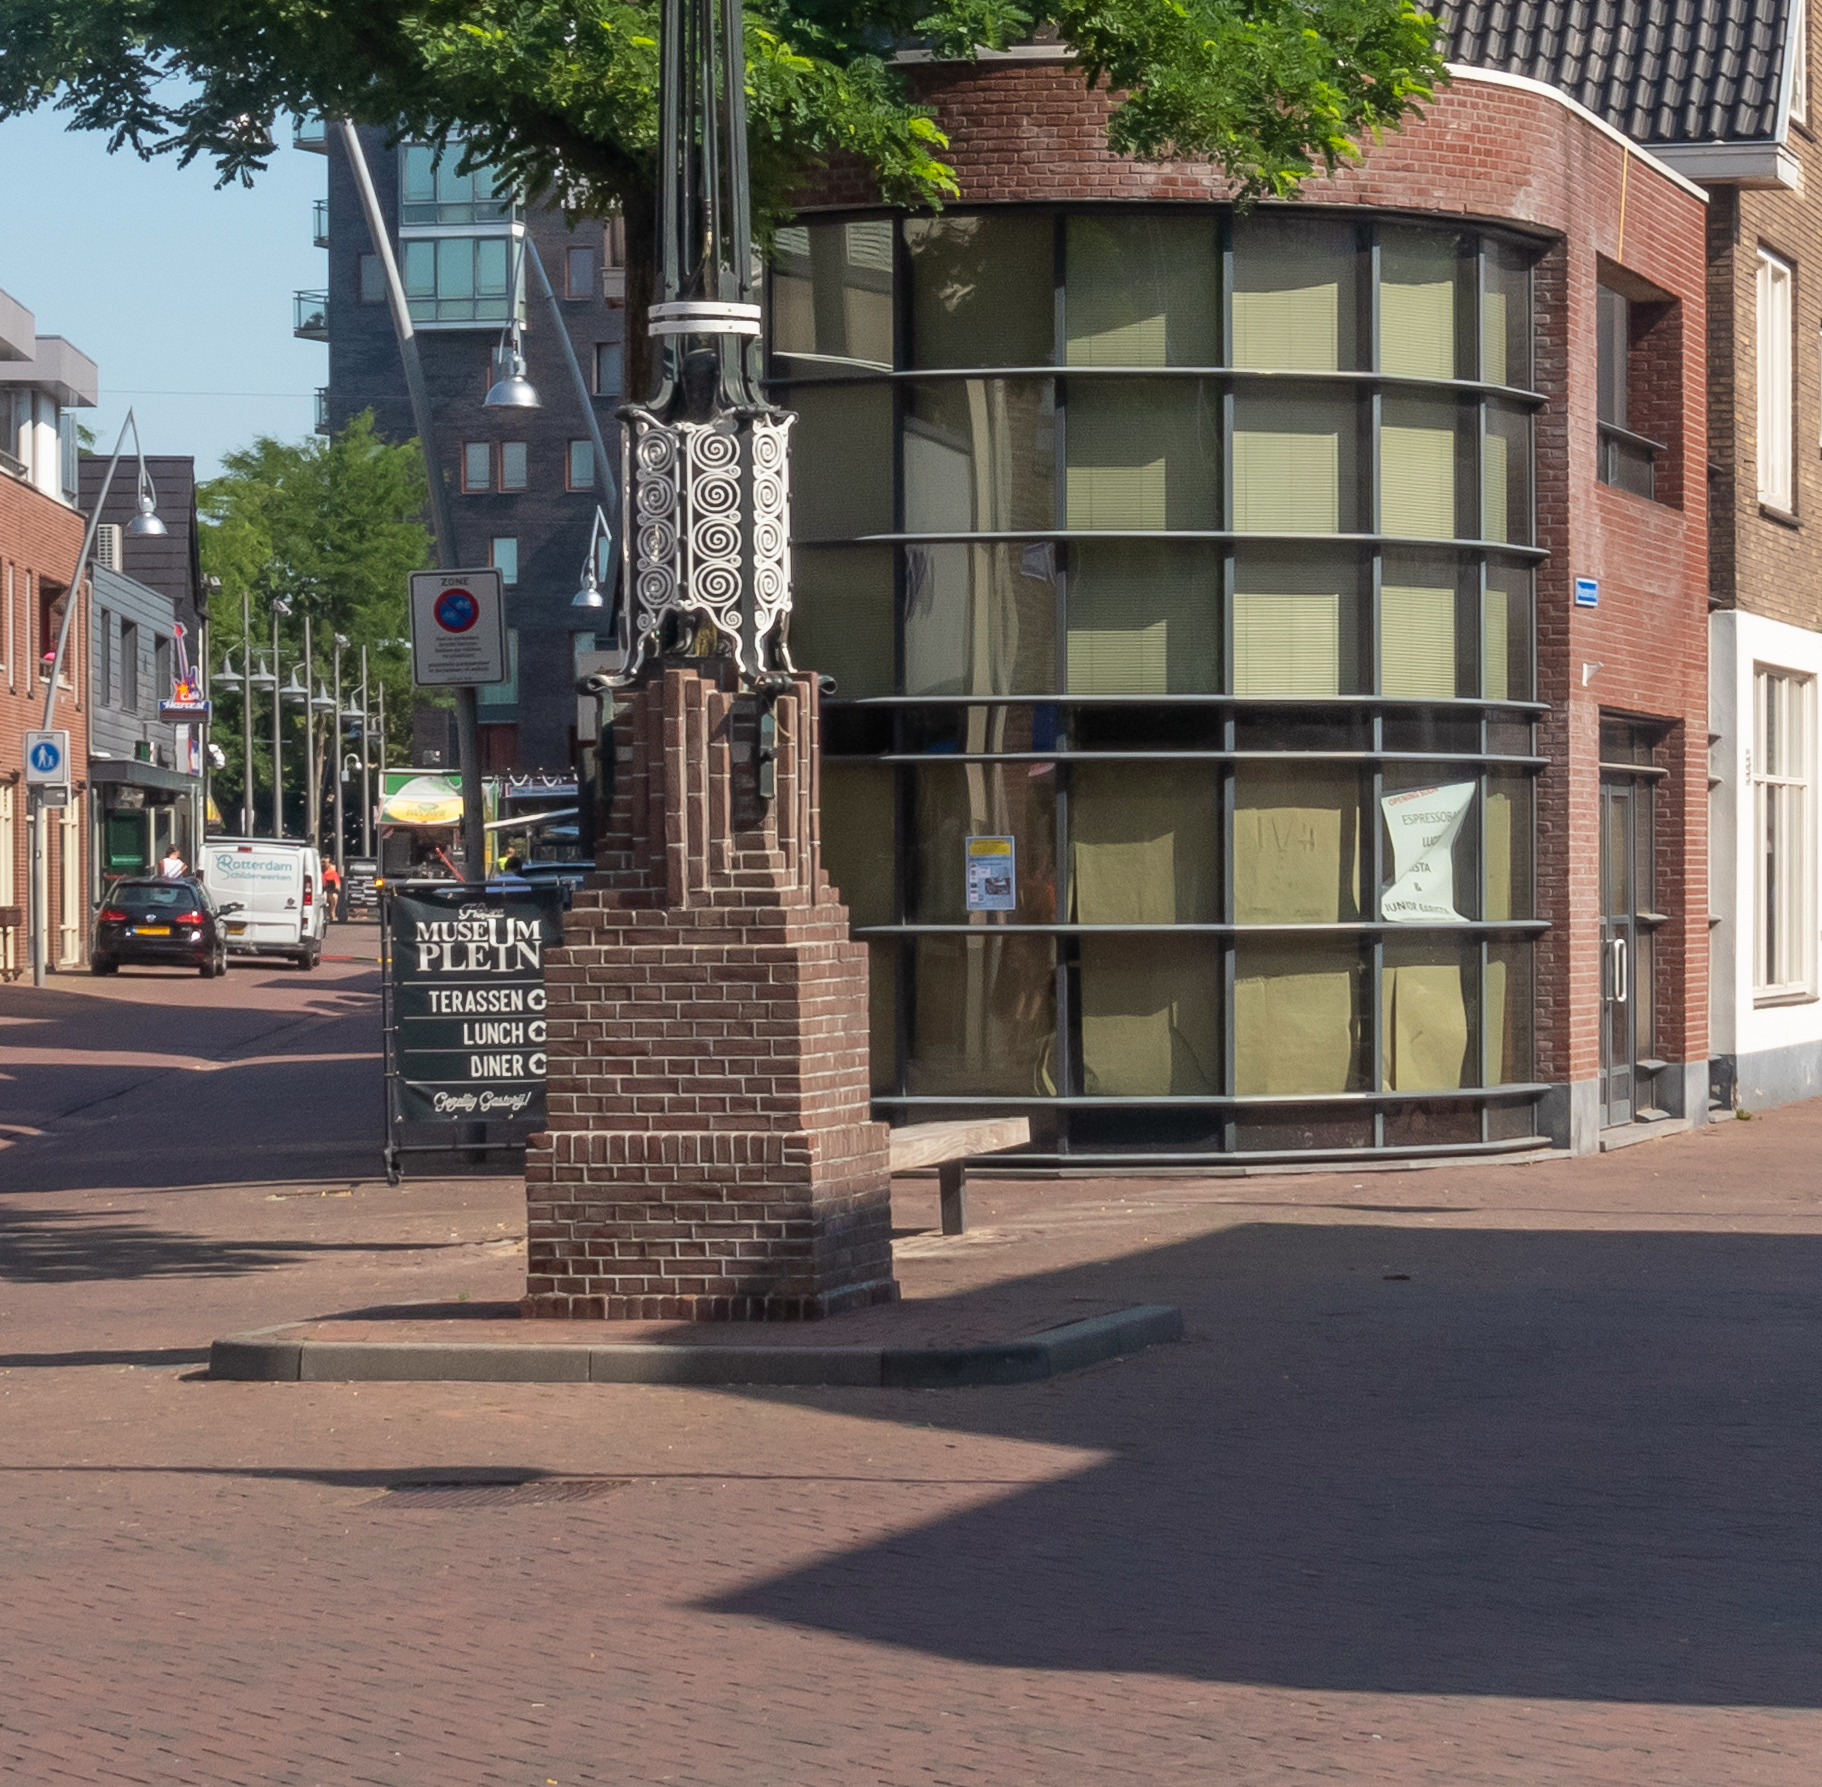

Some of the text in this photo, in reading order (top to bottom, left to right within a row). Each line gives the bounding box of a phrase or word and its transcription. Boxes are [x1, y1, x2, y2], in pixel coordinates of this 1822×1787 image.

[440, 577, 470, 587] ZONE
[215, 854, 293, 872] Rotterdam
[415, 917, 542, 948] MUSEUM
[416, 941, 542, 972] PLEIN
[428, 989, 523, 1013] TERASSEN
[463, 1022, 524, 1045] LUNCH
[470, 1054, 524, 1078] DINER
